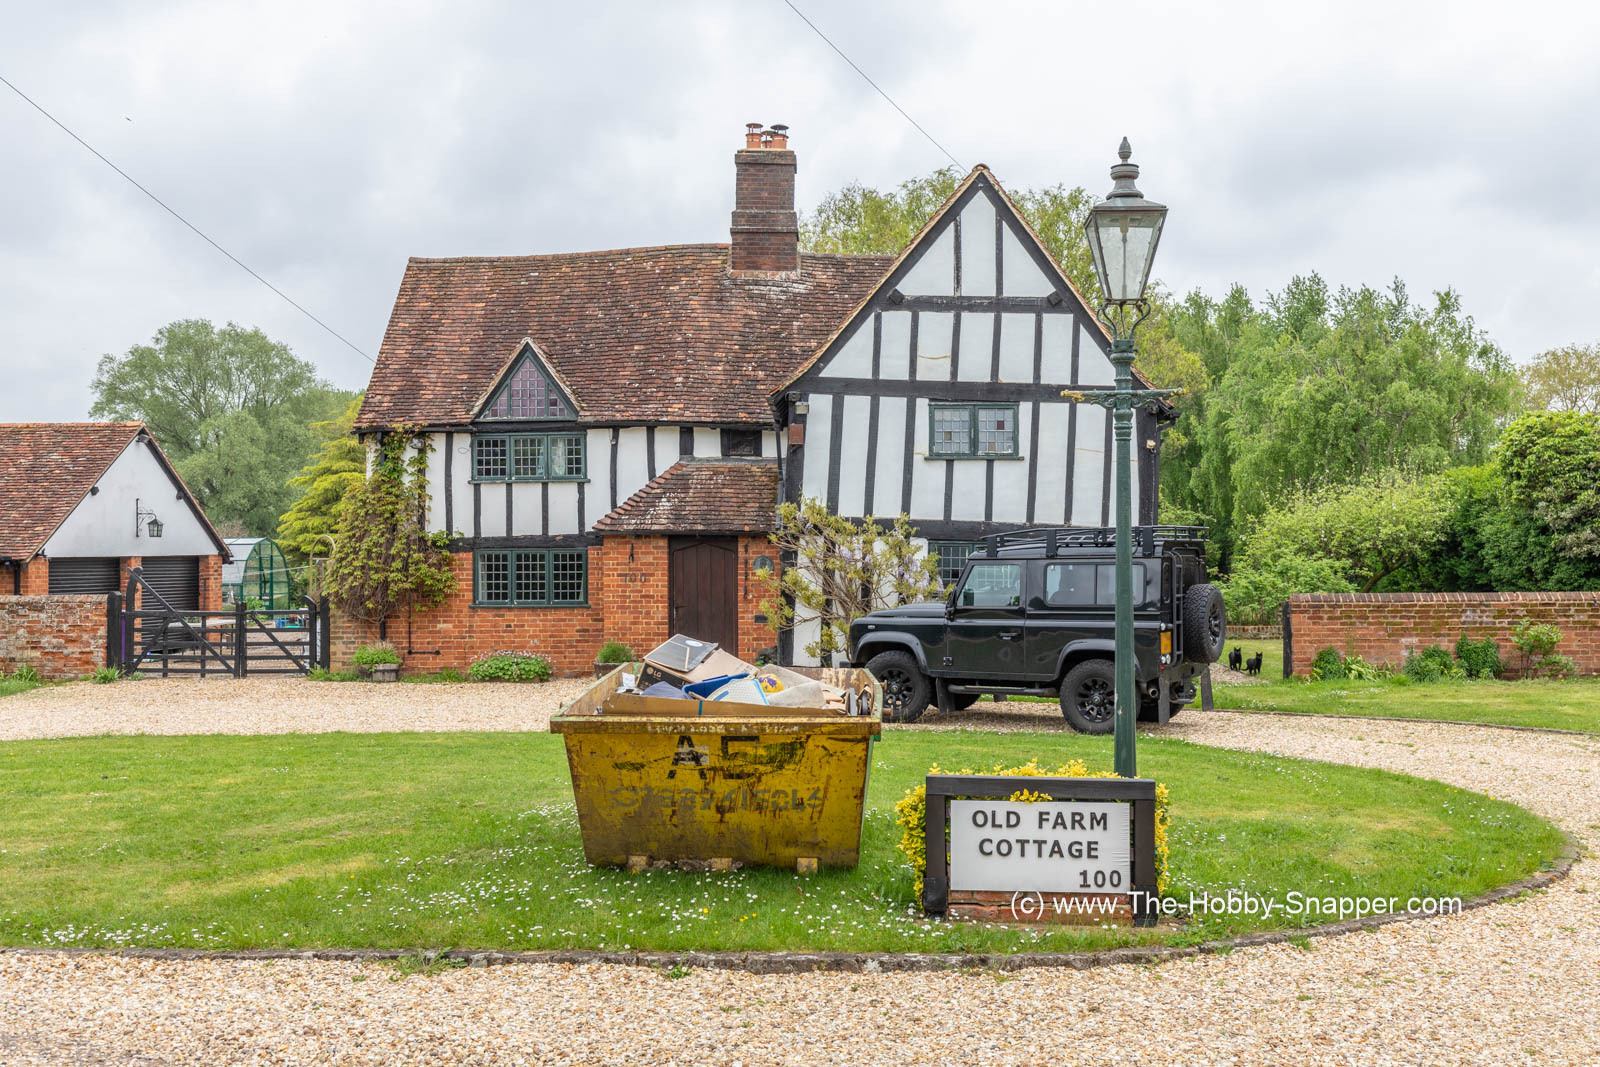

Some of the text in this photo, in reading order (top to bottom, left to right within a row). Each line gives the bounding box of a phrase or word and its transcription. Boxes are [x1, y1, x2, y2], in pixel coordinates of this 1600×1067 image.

[971, 809, 1108, 831] OLD FARM
[978, 838, 1099, 859] COTTAGE
[1079, 869, 1121, 888] 100
